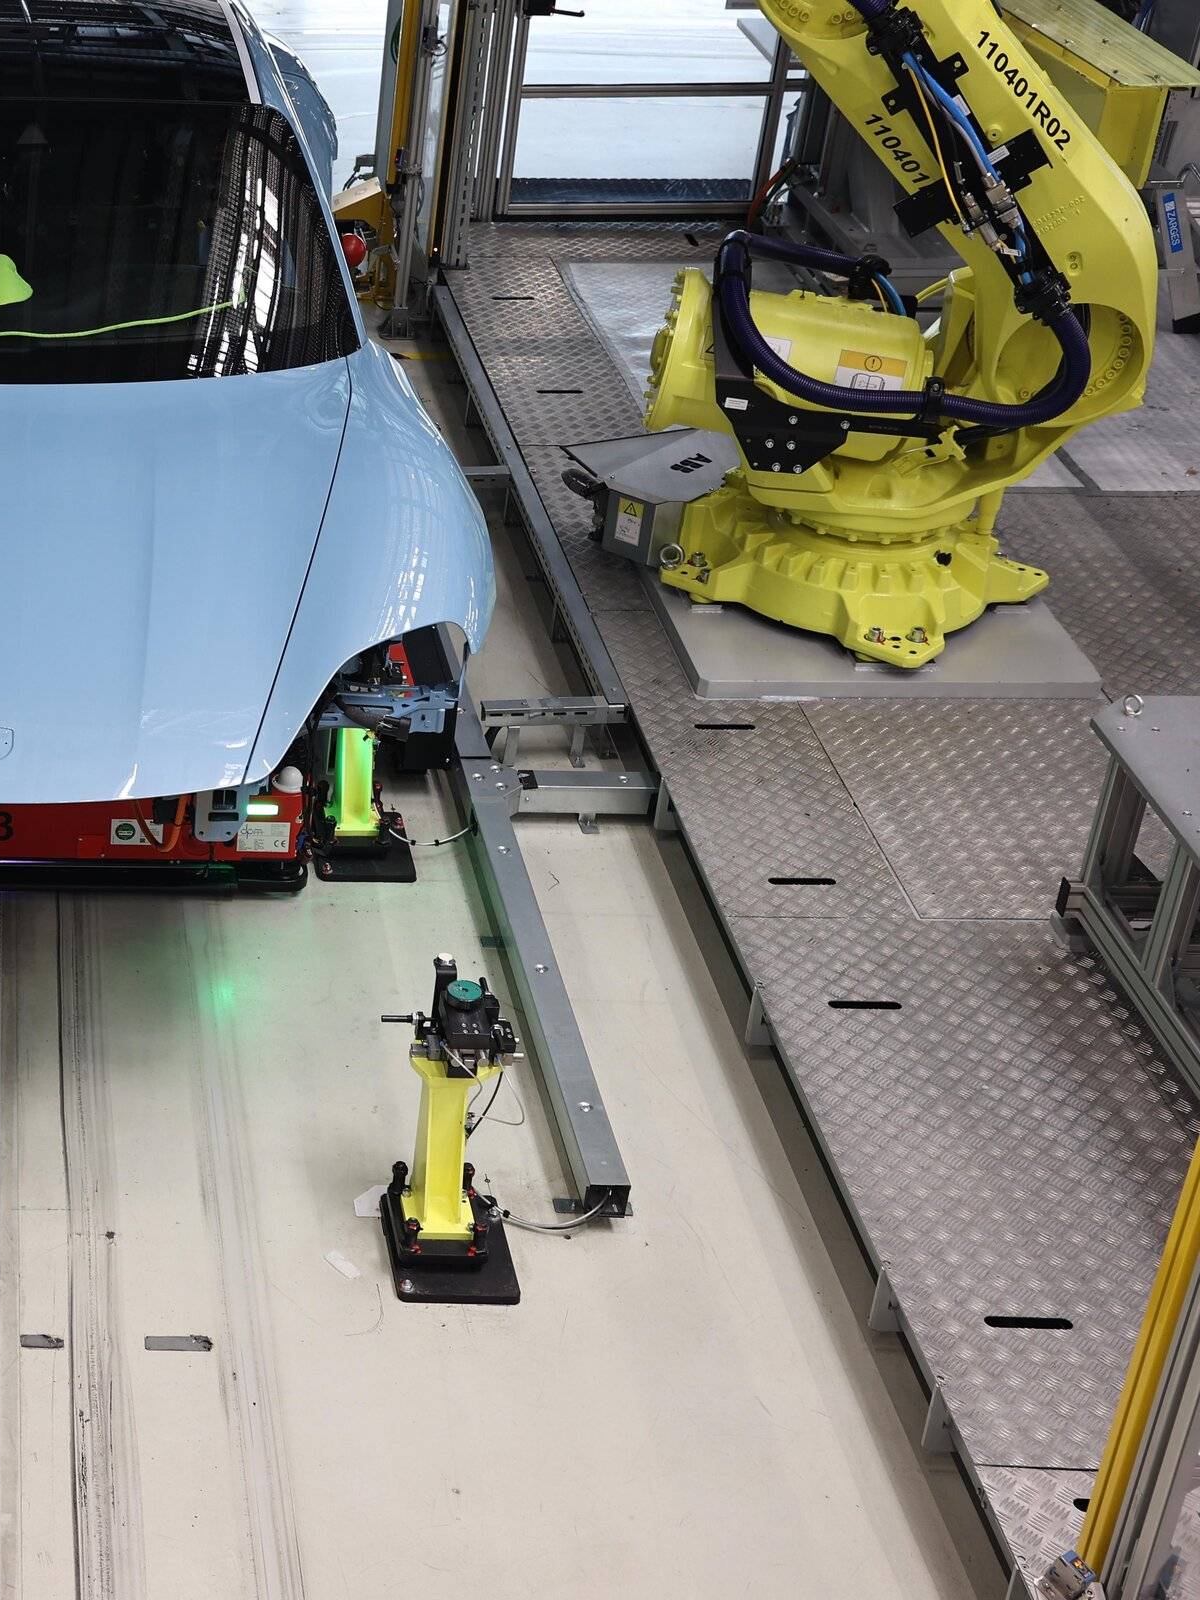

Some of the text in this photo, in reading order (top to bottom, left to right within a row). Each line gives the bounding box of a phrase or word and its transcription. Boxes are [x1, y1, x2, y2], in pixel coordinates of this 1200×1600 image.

[977, 31, 1071, 151] 110401R02
[864, 114, 930, 183] 110401
[1166, 210, 1181, 245] ZARGES
[670, 453, 713, 473] ABB
